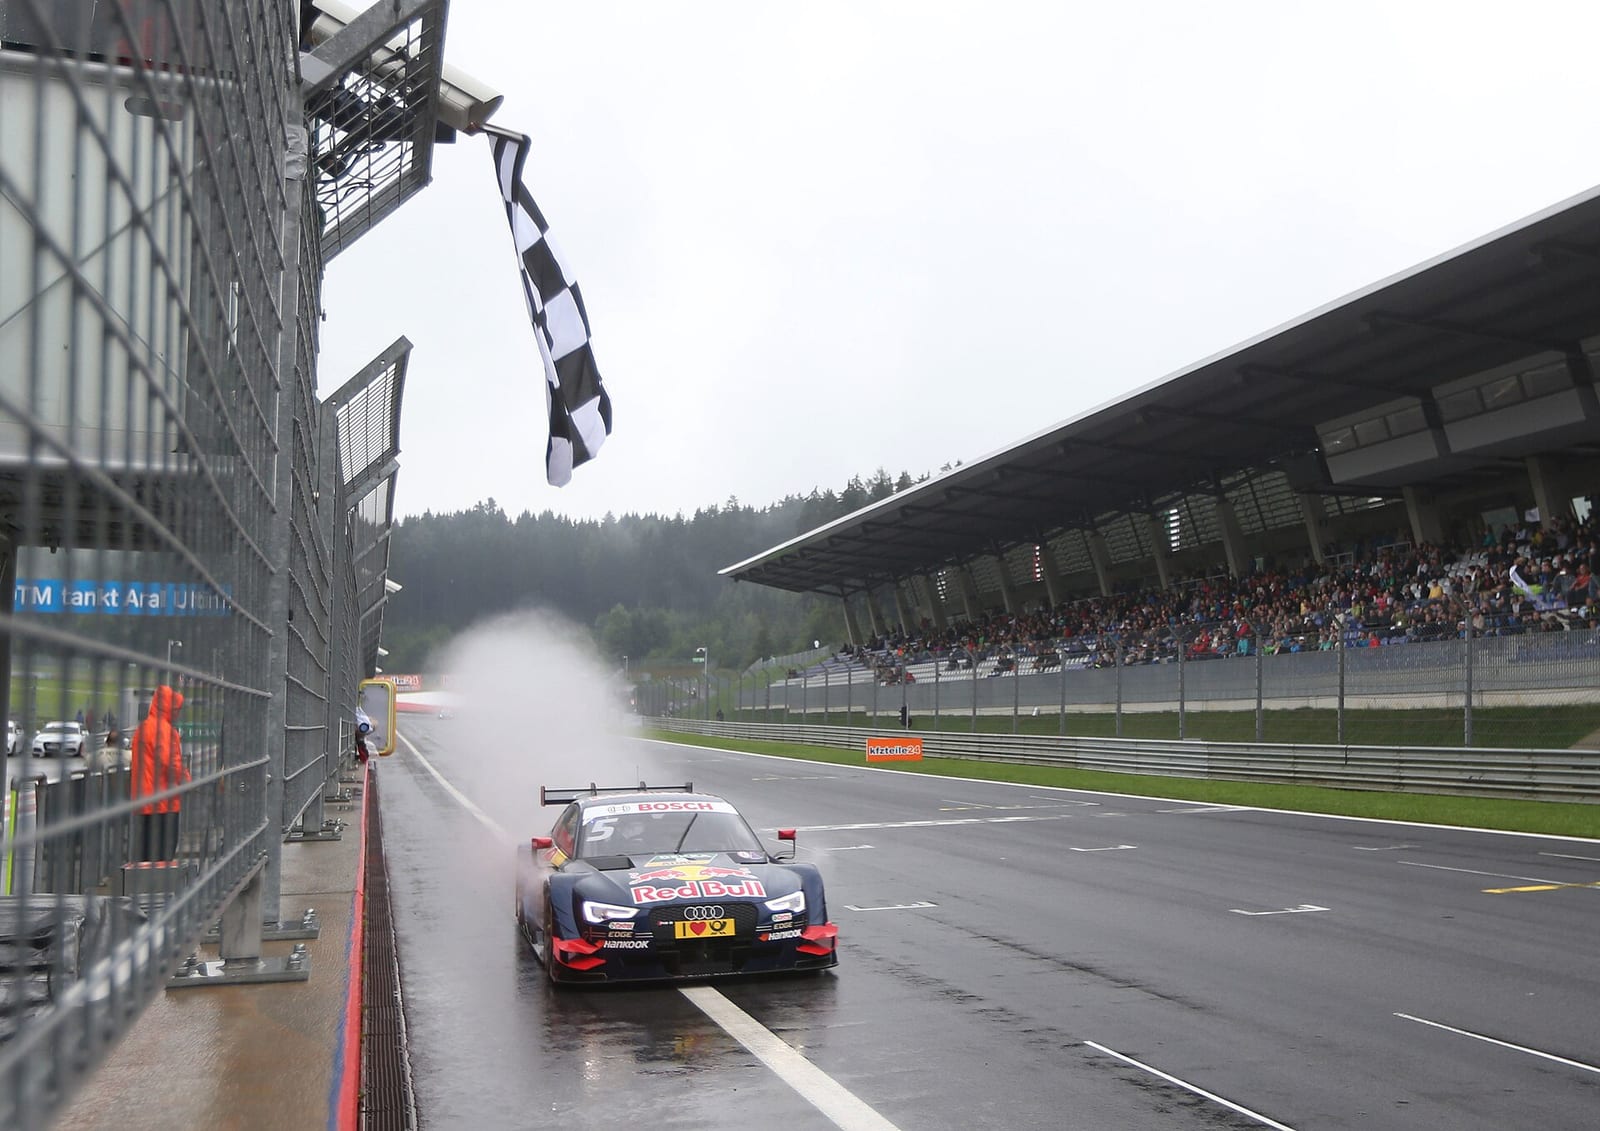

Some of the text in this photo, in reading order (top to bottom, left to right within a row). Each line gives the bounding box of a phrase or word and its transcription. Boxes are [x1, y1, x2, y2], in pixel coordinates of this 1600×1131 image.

[15, 585, 52, 605] TM
[62, 587, 119, 607] tankt
[868, 745, 921, 756] kfzteile24
[638, 802, 714, 812] BOSCH
[586, 817, 619, 842] 5
[632, 881, 764, 903] Red Bull
